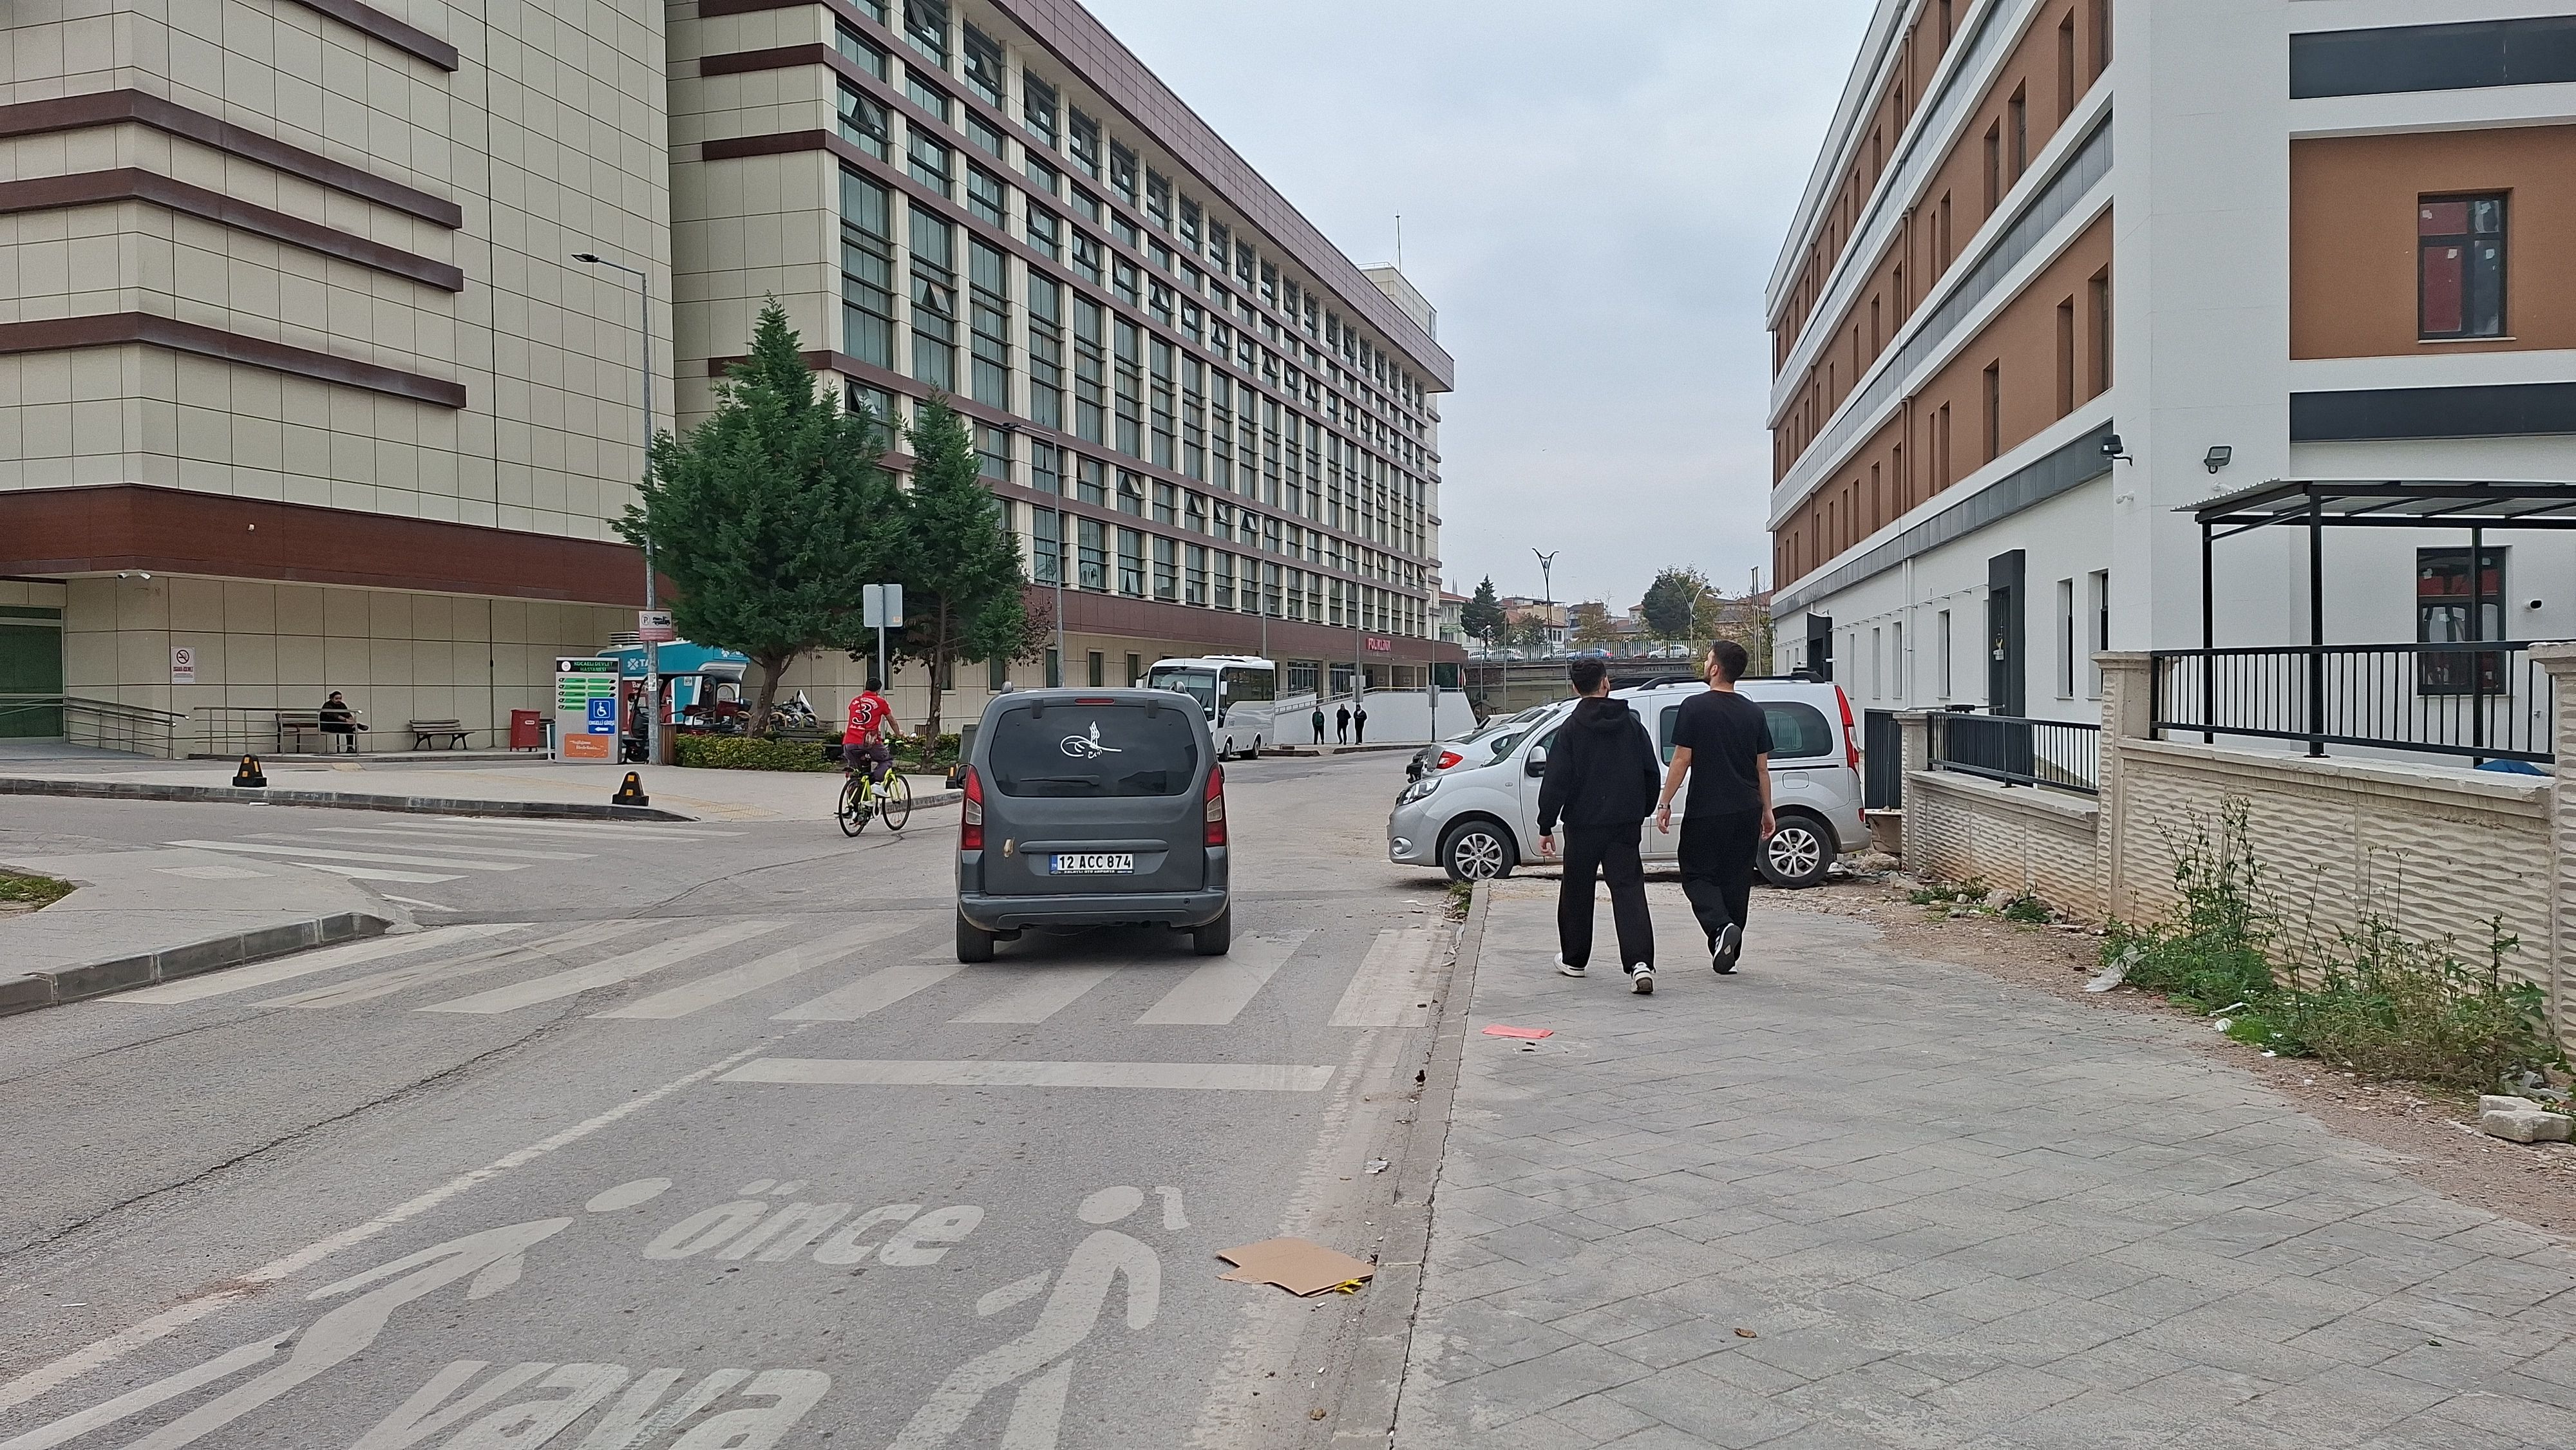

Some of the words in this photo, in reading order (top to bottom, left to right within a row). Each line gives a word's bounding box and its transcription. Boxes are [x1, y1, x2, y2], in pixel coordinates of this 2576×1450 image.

[852, 703, 872, 725] 3
[1059, 856, 1074, 869] 12
[1079, 856, 1103, 868] ACC
[1107, 856, 1131, 868] 874
[643, 1178, 985, 1267] önce
